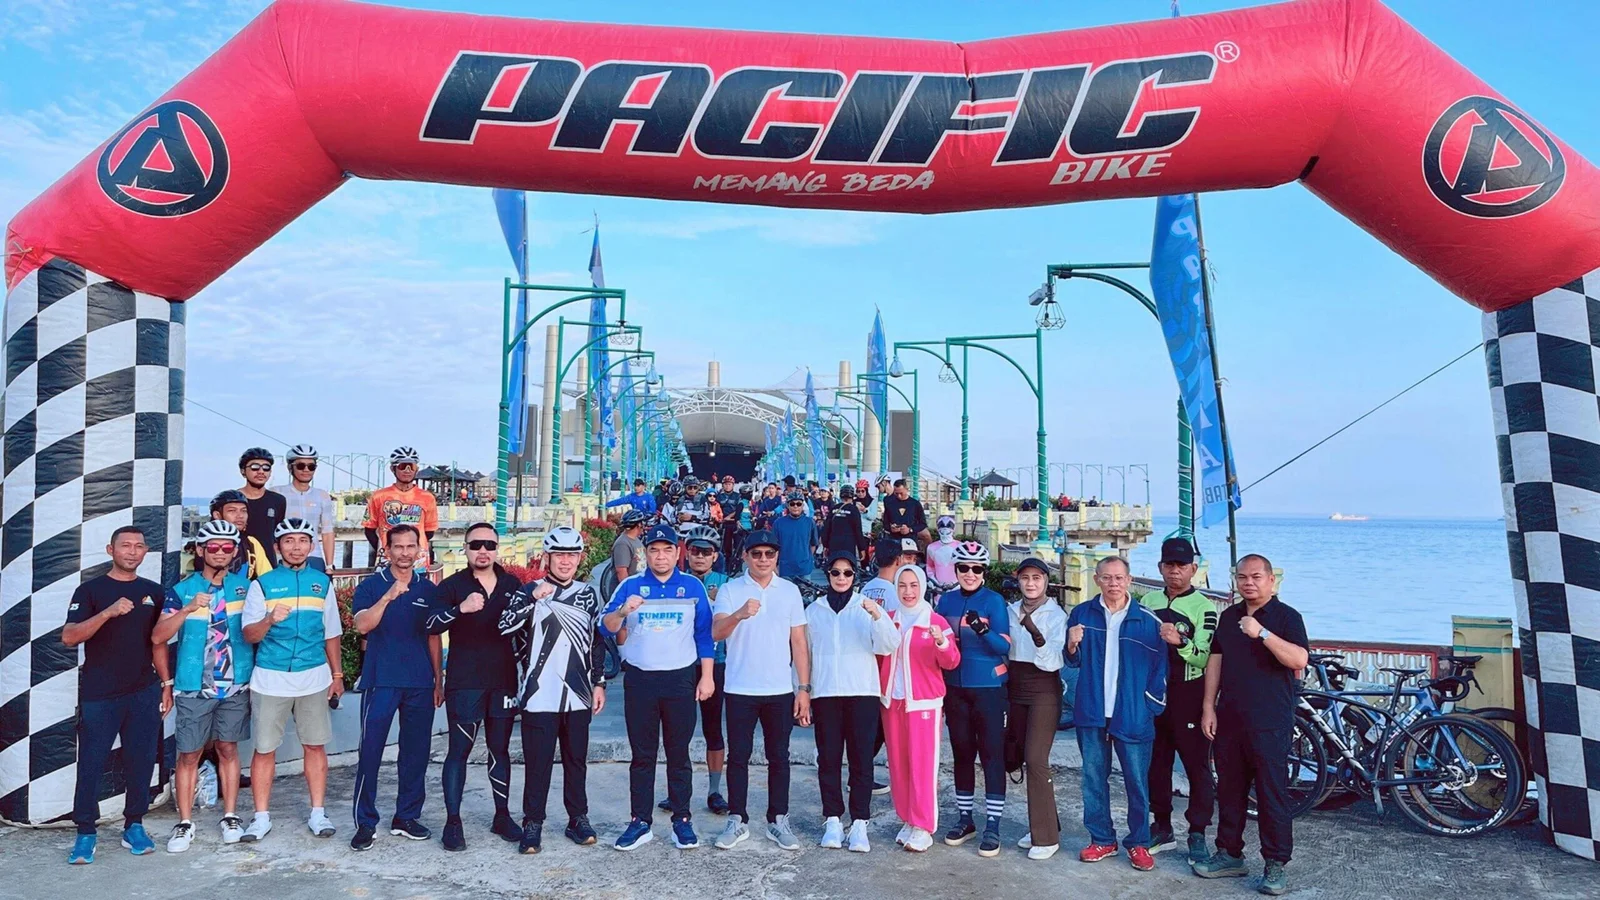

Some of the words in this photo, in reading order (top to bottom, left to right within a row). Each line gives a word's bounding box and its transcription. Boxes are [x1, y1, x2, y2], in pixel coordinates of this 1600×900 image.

[419, 50, 1218, 167] PACIFIC
[1049, 152, 1172, 185] BIKE
[693, 171, 827, 192] MEMANG
[841, 170, 935, 191] BEDA
[638, 612, 683, 624] FUNBIKE
[1442, 824, 1482, 834] SWISS
